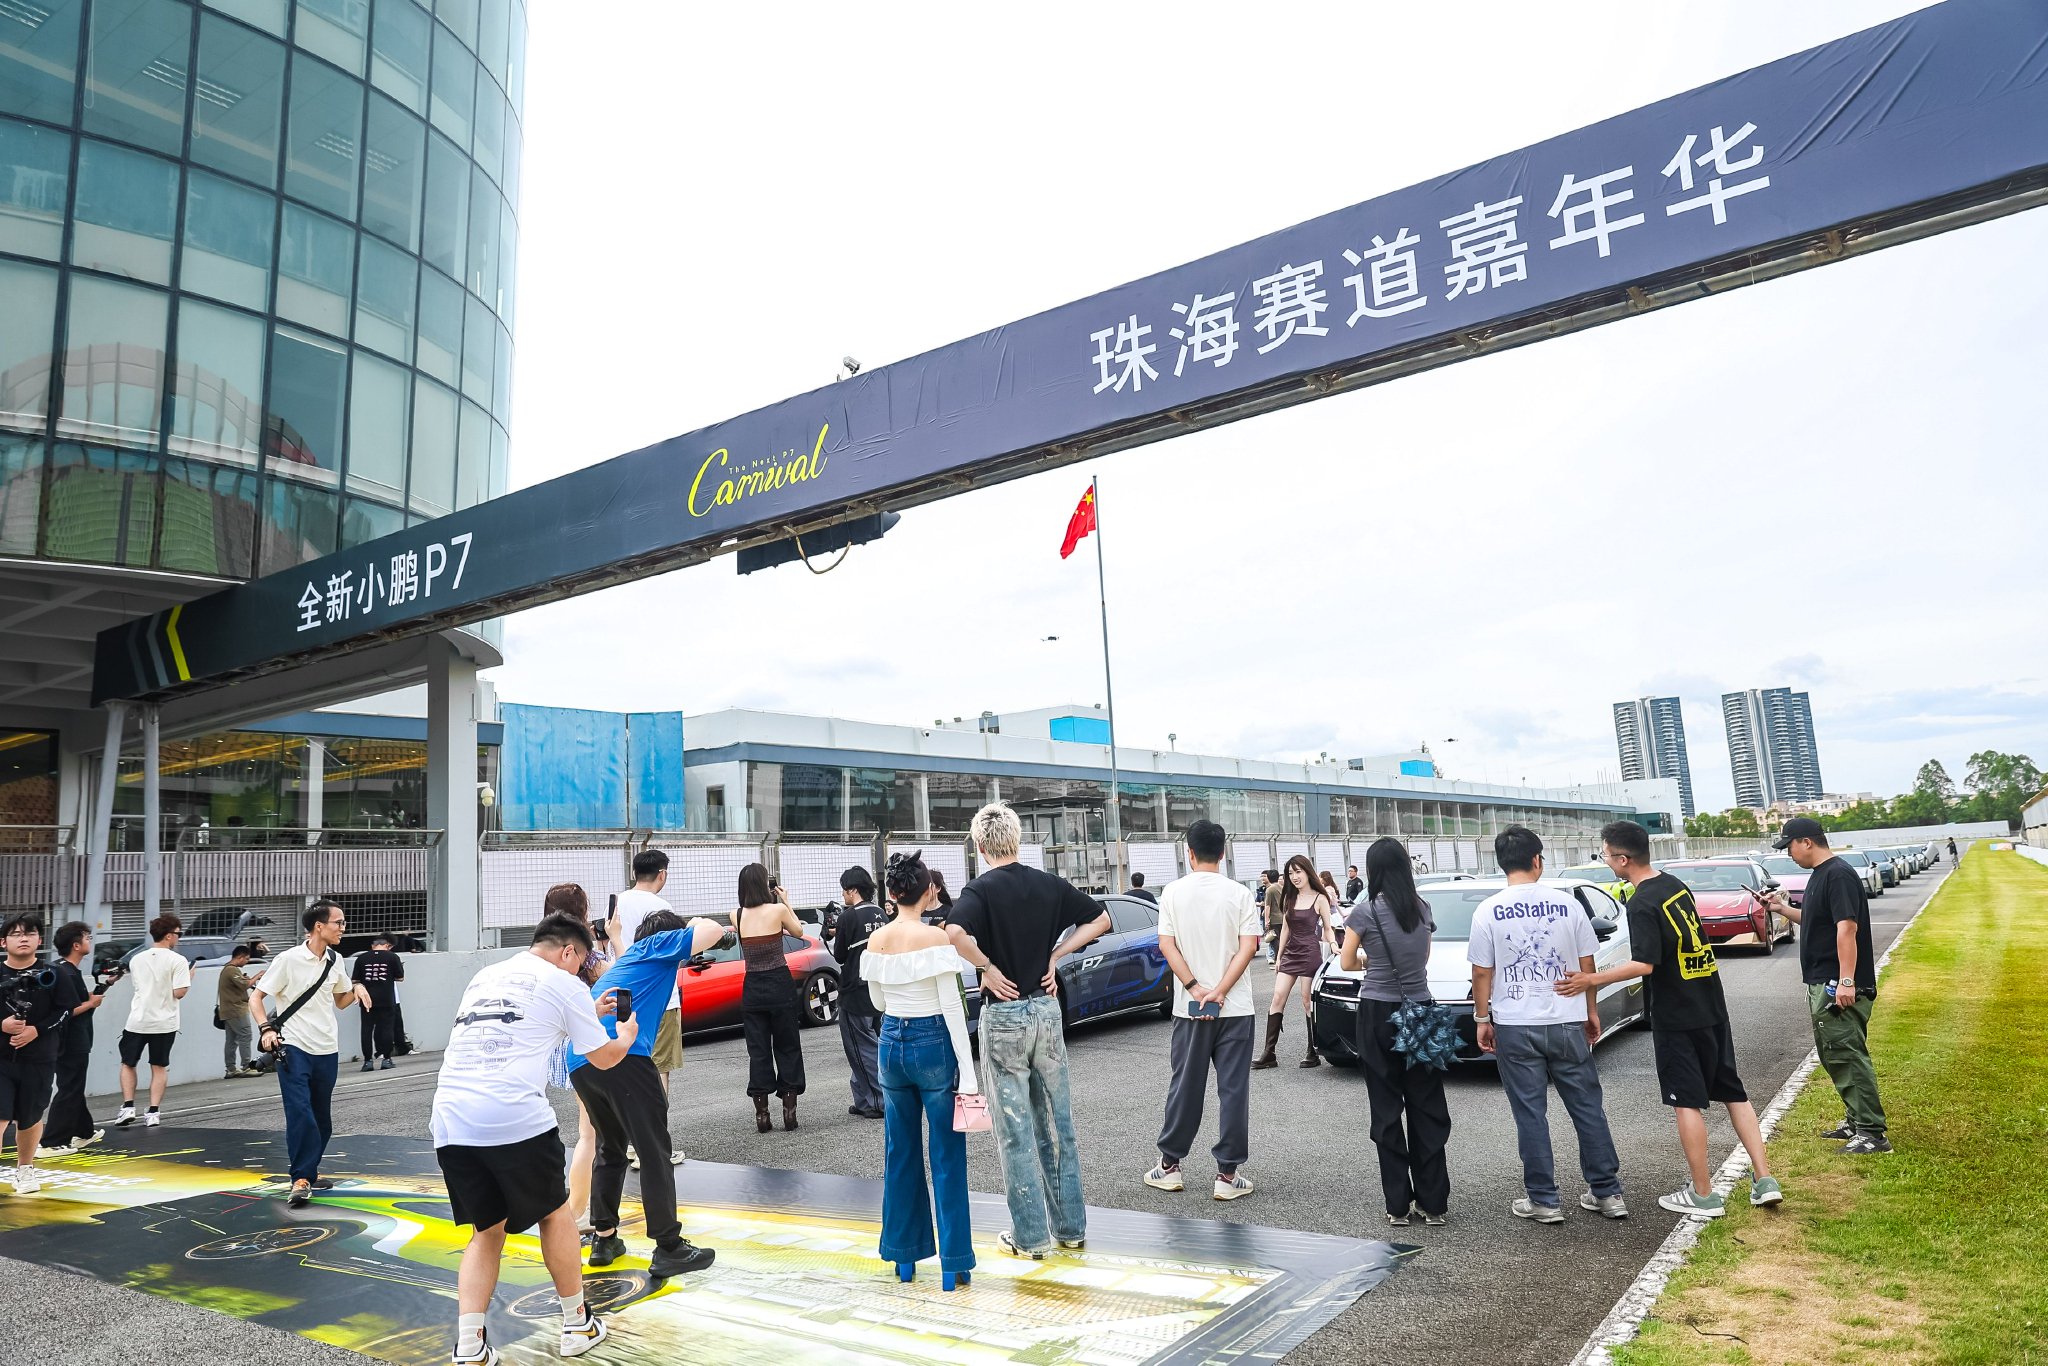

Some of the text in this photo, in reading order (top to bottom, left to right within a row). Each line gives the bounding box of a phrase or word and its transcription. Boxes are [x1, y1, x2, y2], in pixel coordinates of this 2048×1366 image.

[1090, 121, 1771, 395] 珠海赛道嘉年华
[687, 423, 829, 518] Carnival
[729, 448, 795, 475] The Next P7
[297, 532, 473, 632] 全新小鹏P7
[1493, 901, 1568, 921] GaStation
[1081, 955, 1104, 971] P7
